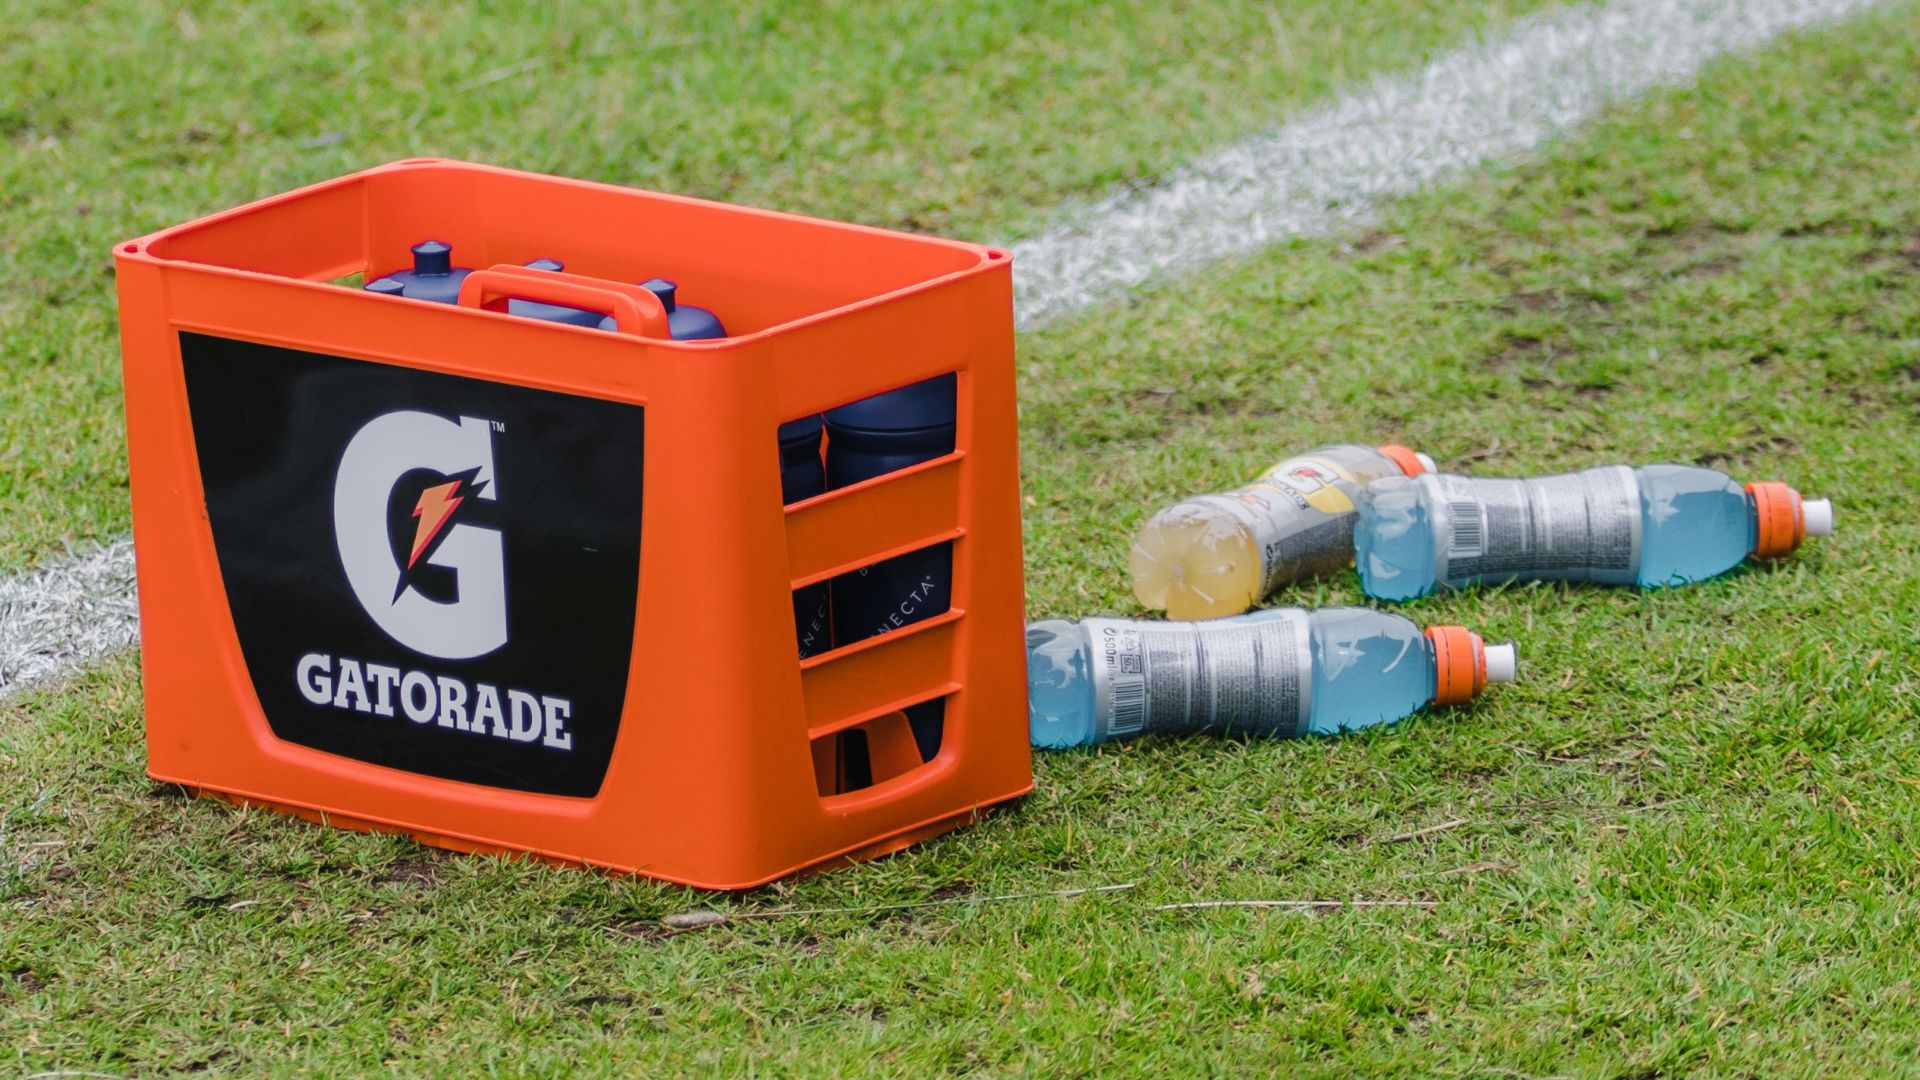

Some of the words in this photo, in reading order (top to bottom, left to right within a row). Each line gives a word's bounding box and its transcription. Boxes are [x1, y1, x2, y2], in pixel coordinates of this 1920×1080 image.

[490, 420, 505, 433] TM
[333, 409, 508, 661] G
[296, 653, 573, 751] GATORADE
